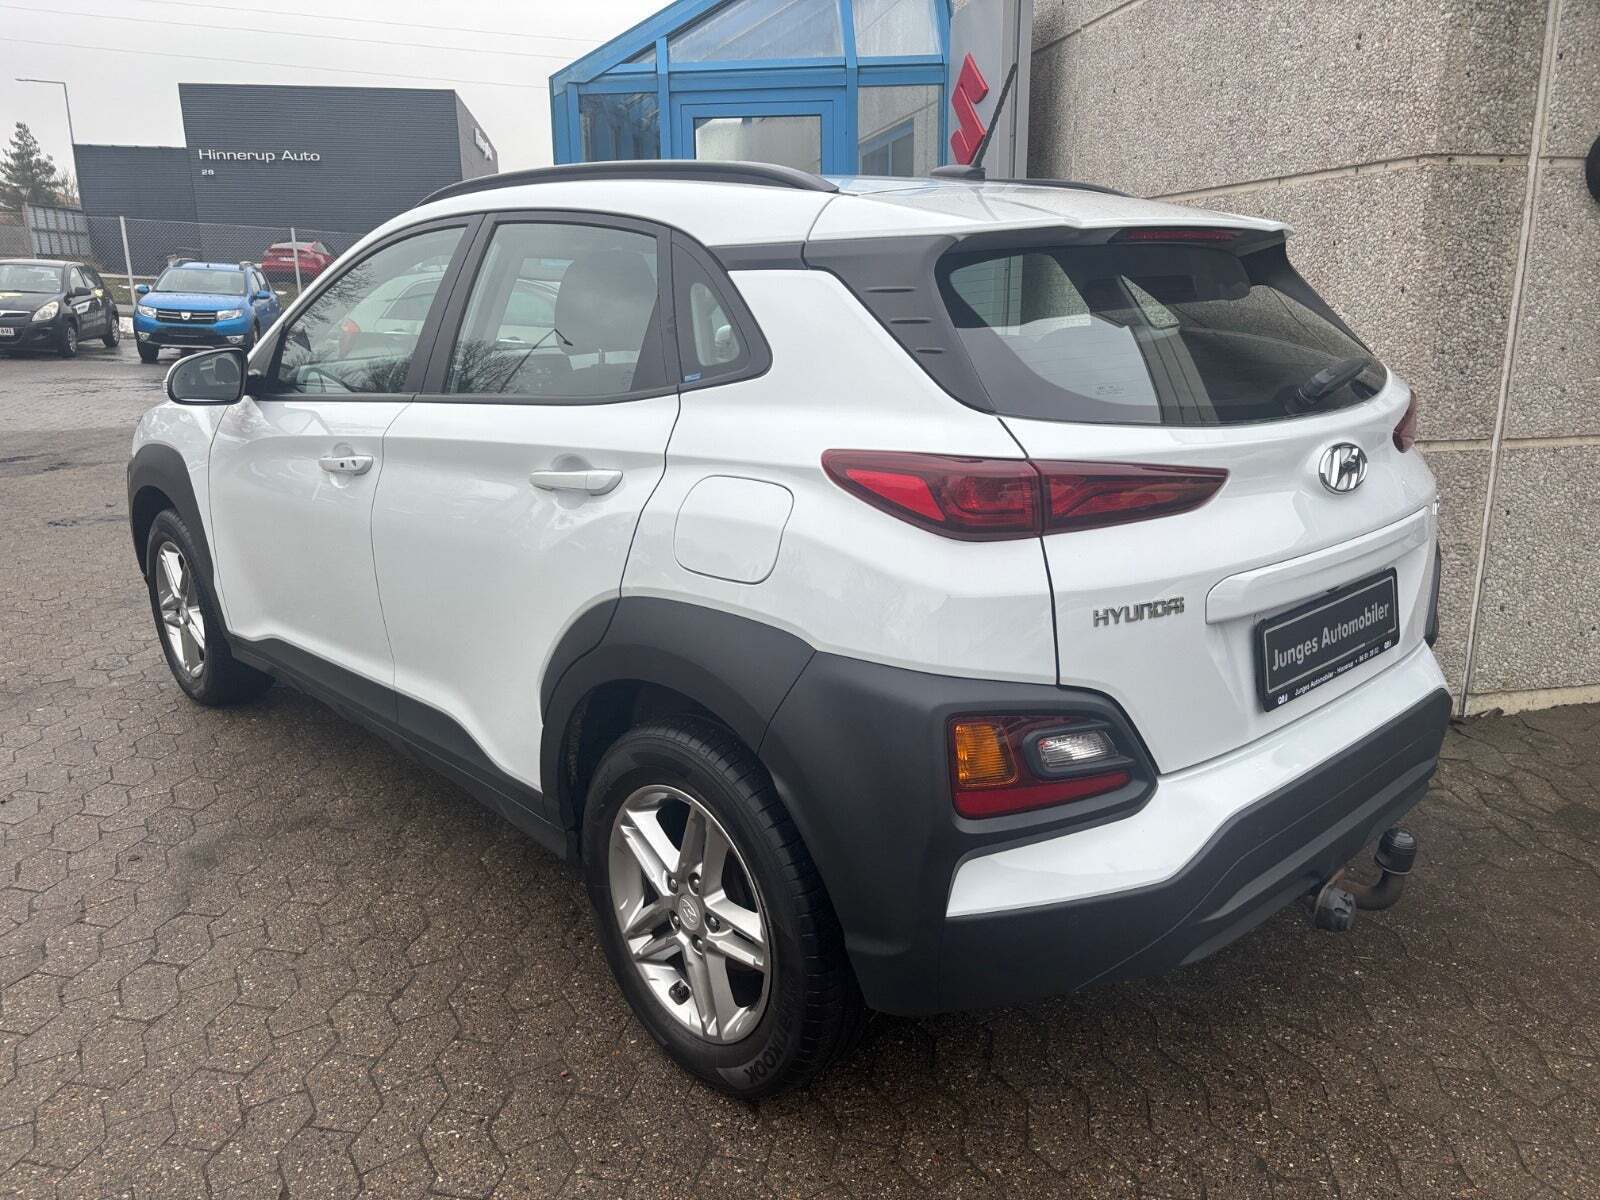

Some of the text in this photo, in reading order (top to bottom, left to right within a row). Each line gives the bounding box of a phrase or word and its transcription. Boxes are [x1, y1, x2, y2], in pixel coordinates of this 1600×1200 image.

[198, 149, 320, 164] Hinnerup Auto
[1093, 597, 1184, 628] HYUNDAI
[1272, 602, 1389, 671] Junges Automobiler
